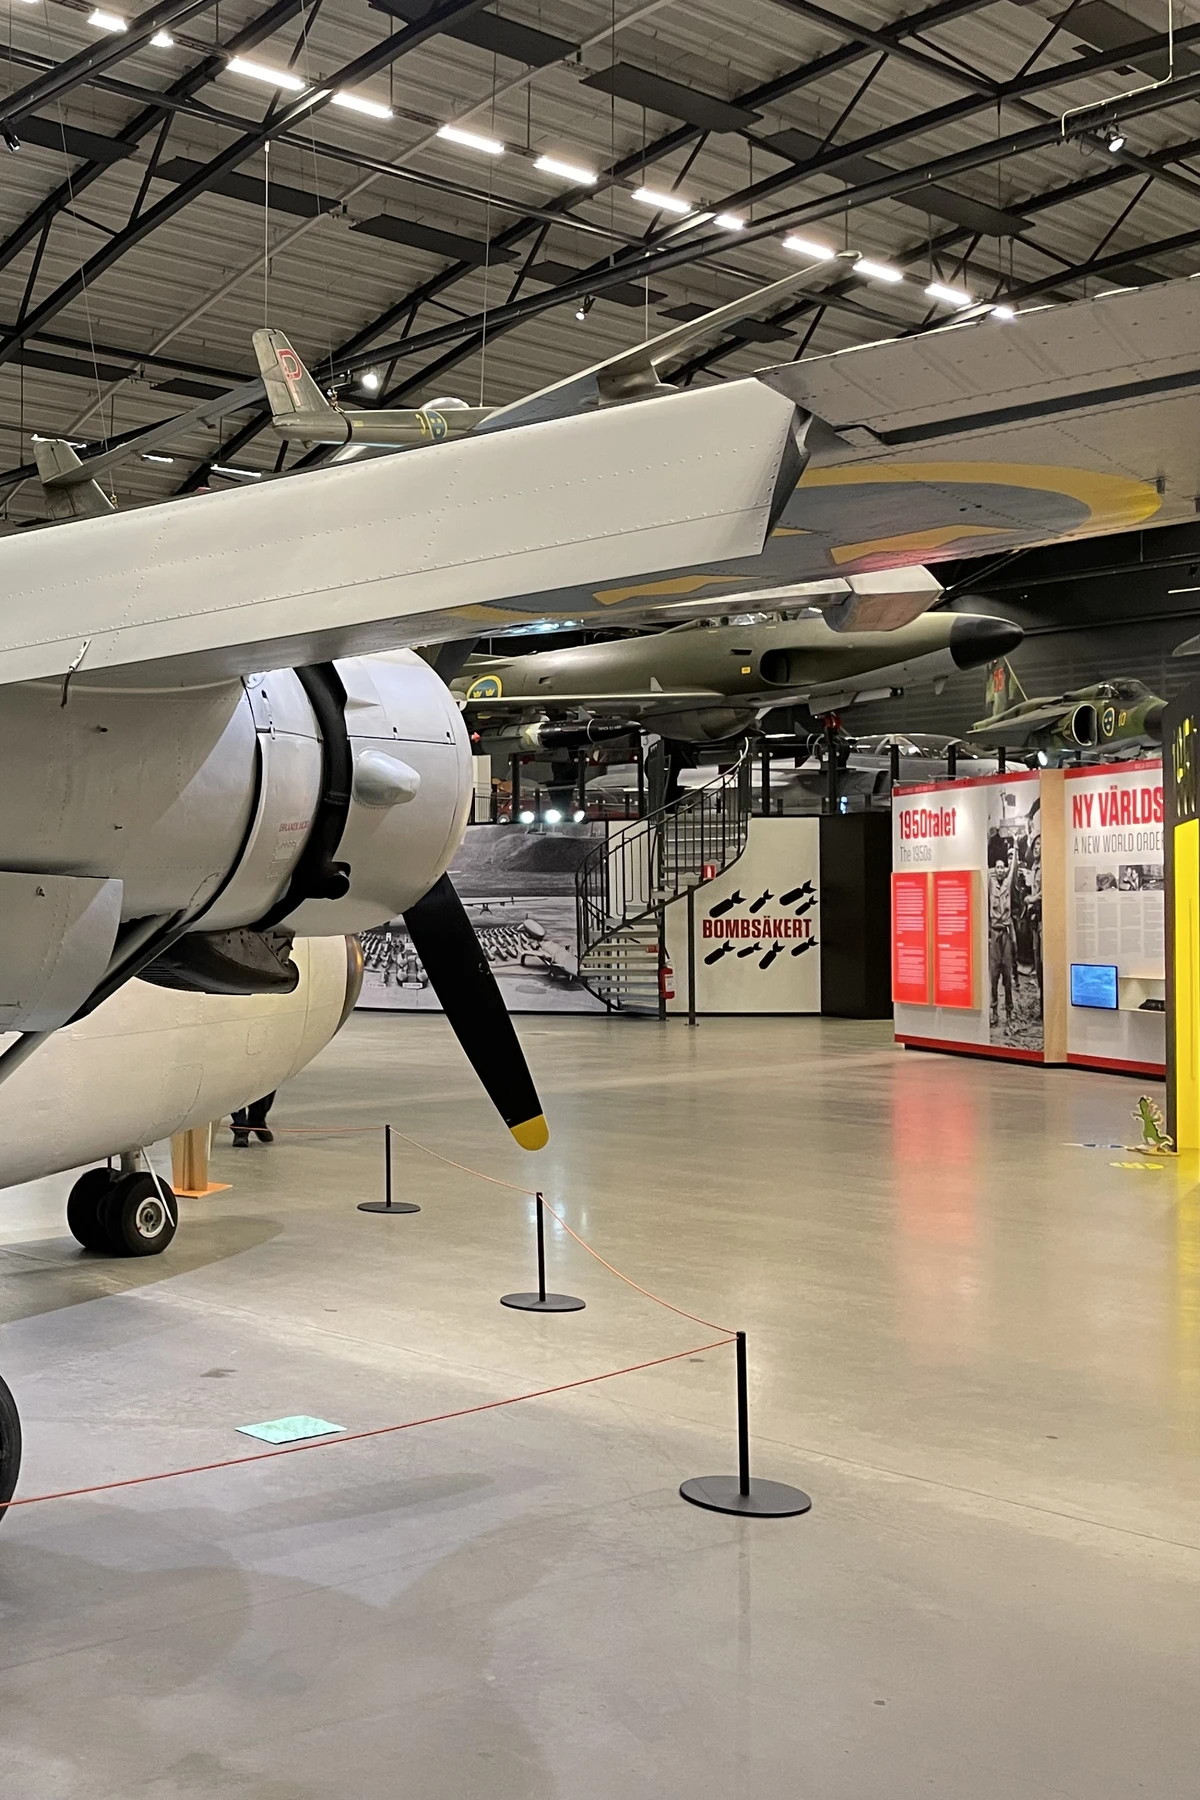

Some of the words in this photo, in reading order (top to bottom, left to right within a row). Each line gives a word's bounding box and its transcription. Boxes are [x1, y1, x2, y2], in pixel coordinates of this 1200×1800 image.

[276, 349, 302, 406] P
[1072, 793, 1094, 829] NY
[1098, 785, 1165, 827] VÄRLDS
[899, 807, 957, 840] 1950talet
[900, 846, 911, 862] The
[913, 845, 931, 862] 1950s
[1073, 836, 1079, 854] A
[1081, 835, 1100, 854] NEW
[1102, 833, 1133, 853] WORLD
[703, 915, 812, 939] BOMBSÄKERT
